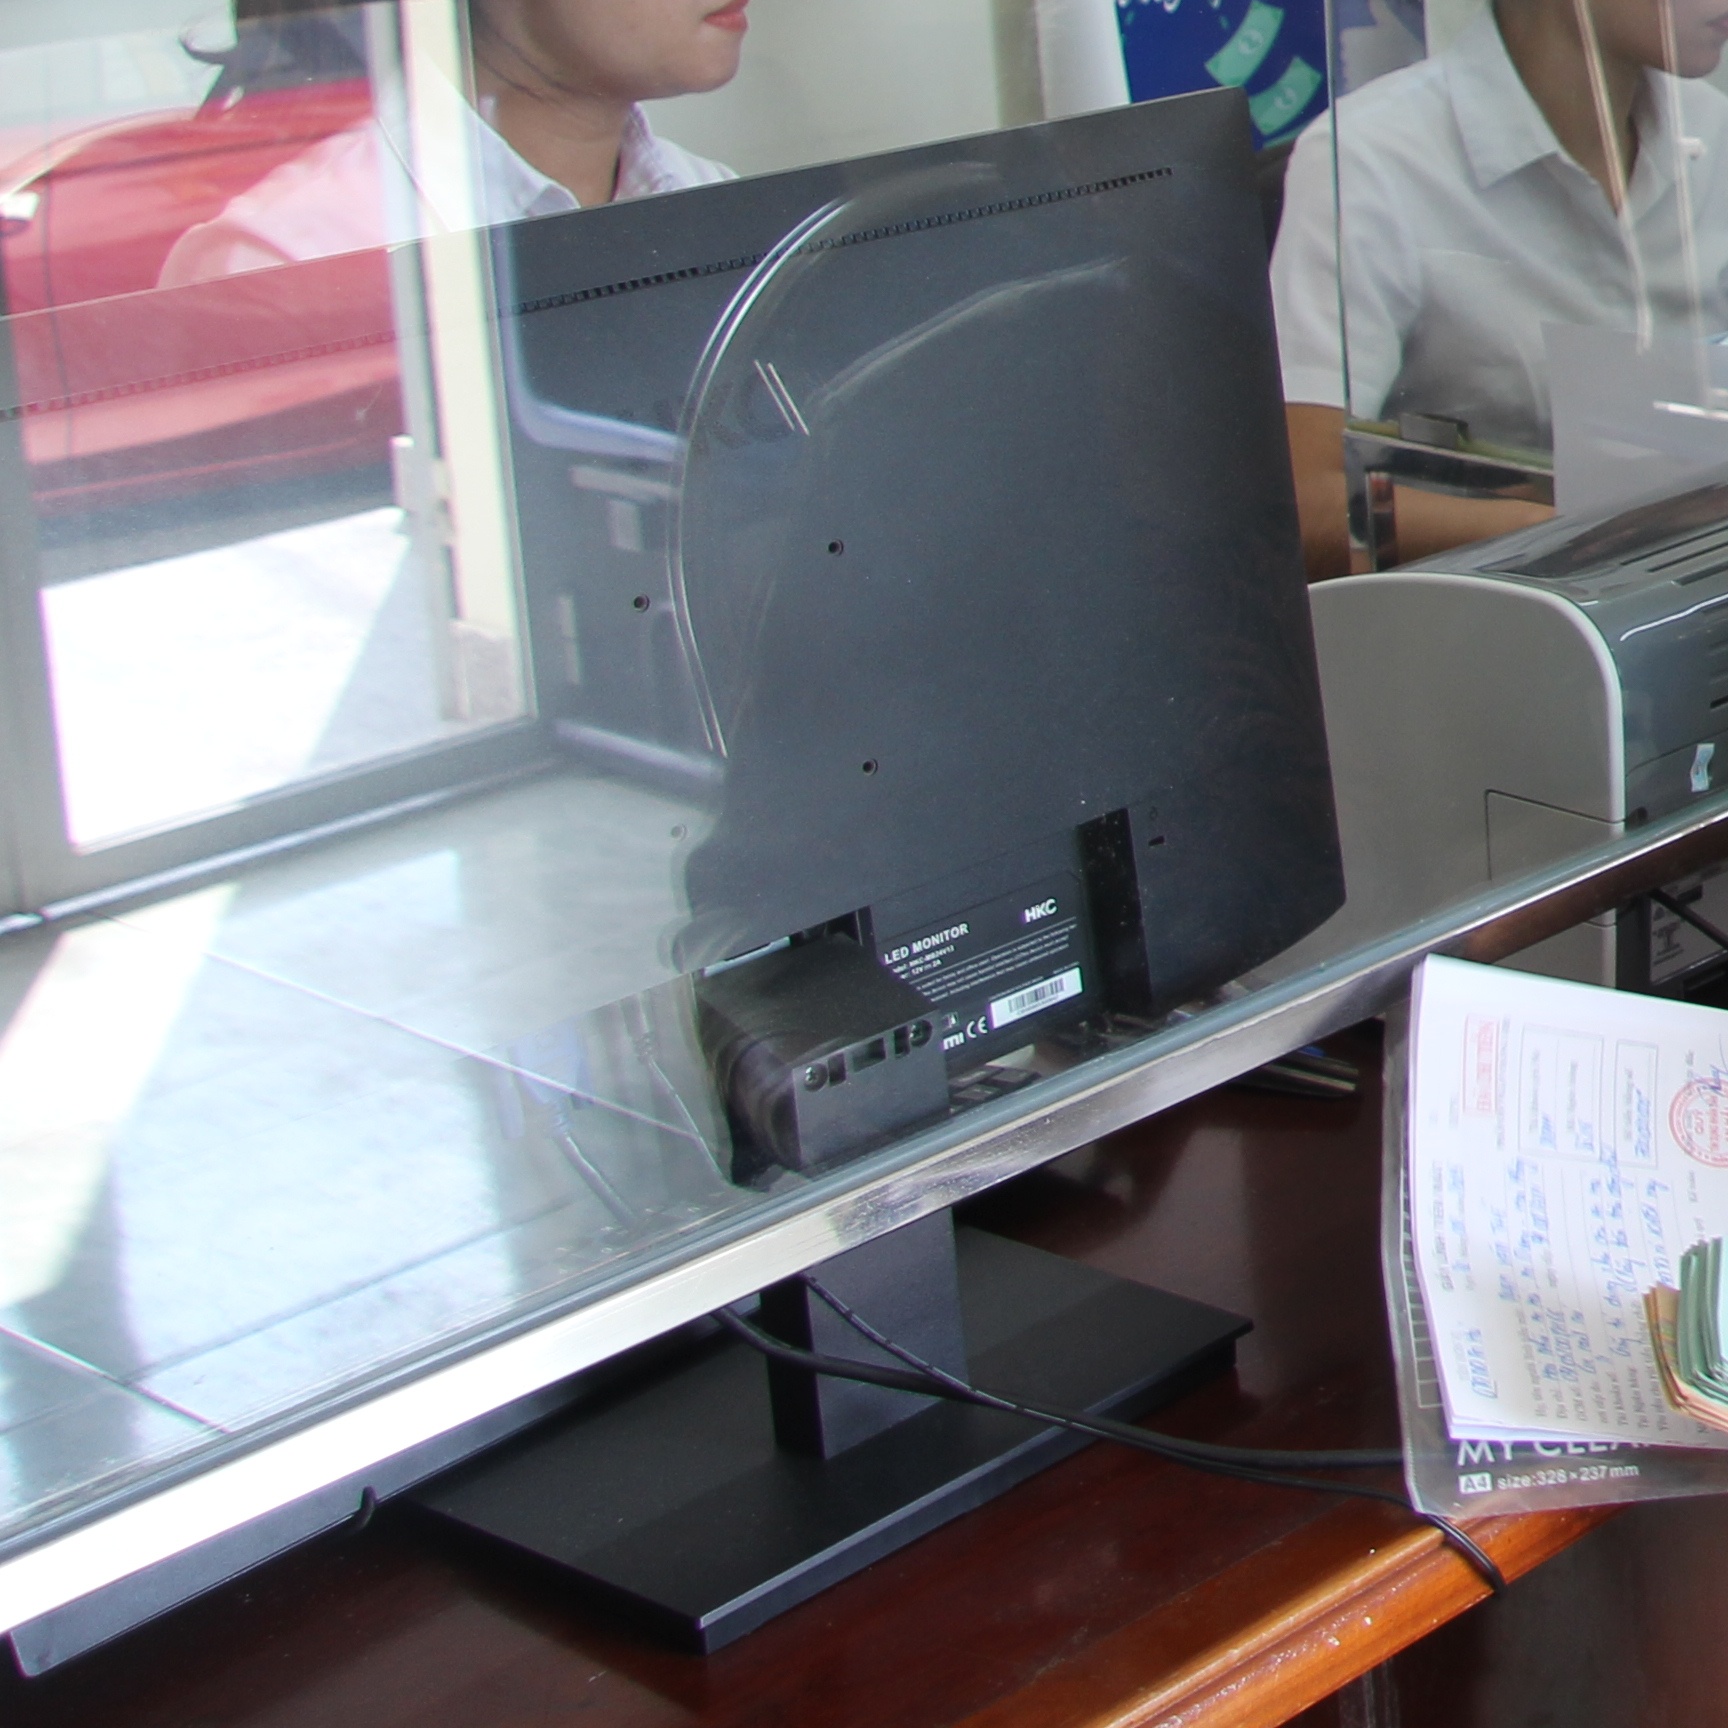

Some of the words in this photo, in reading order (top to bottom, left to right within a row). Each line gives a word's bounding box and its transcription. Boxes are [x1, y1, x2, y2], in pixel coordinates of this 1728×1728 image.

[1023, 898, 1058, 923] HKC
[884, 945, 910, 965] LED
[911, 922, 970, 955] MONITOR
[1460, 1475, 1491, 1492] A4
